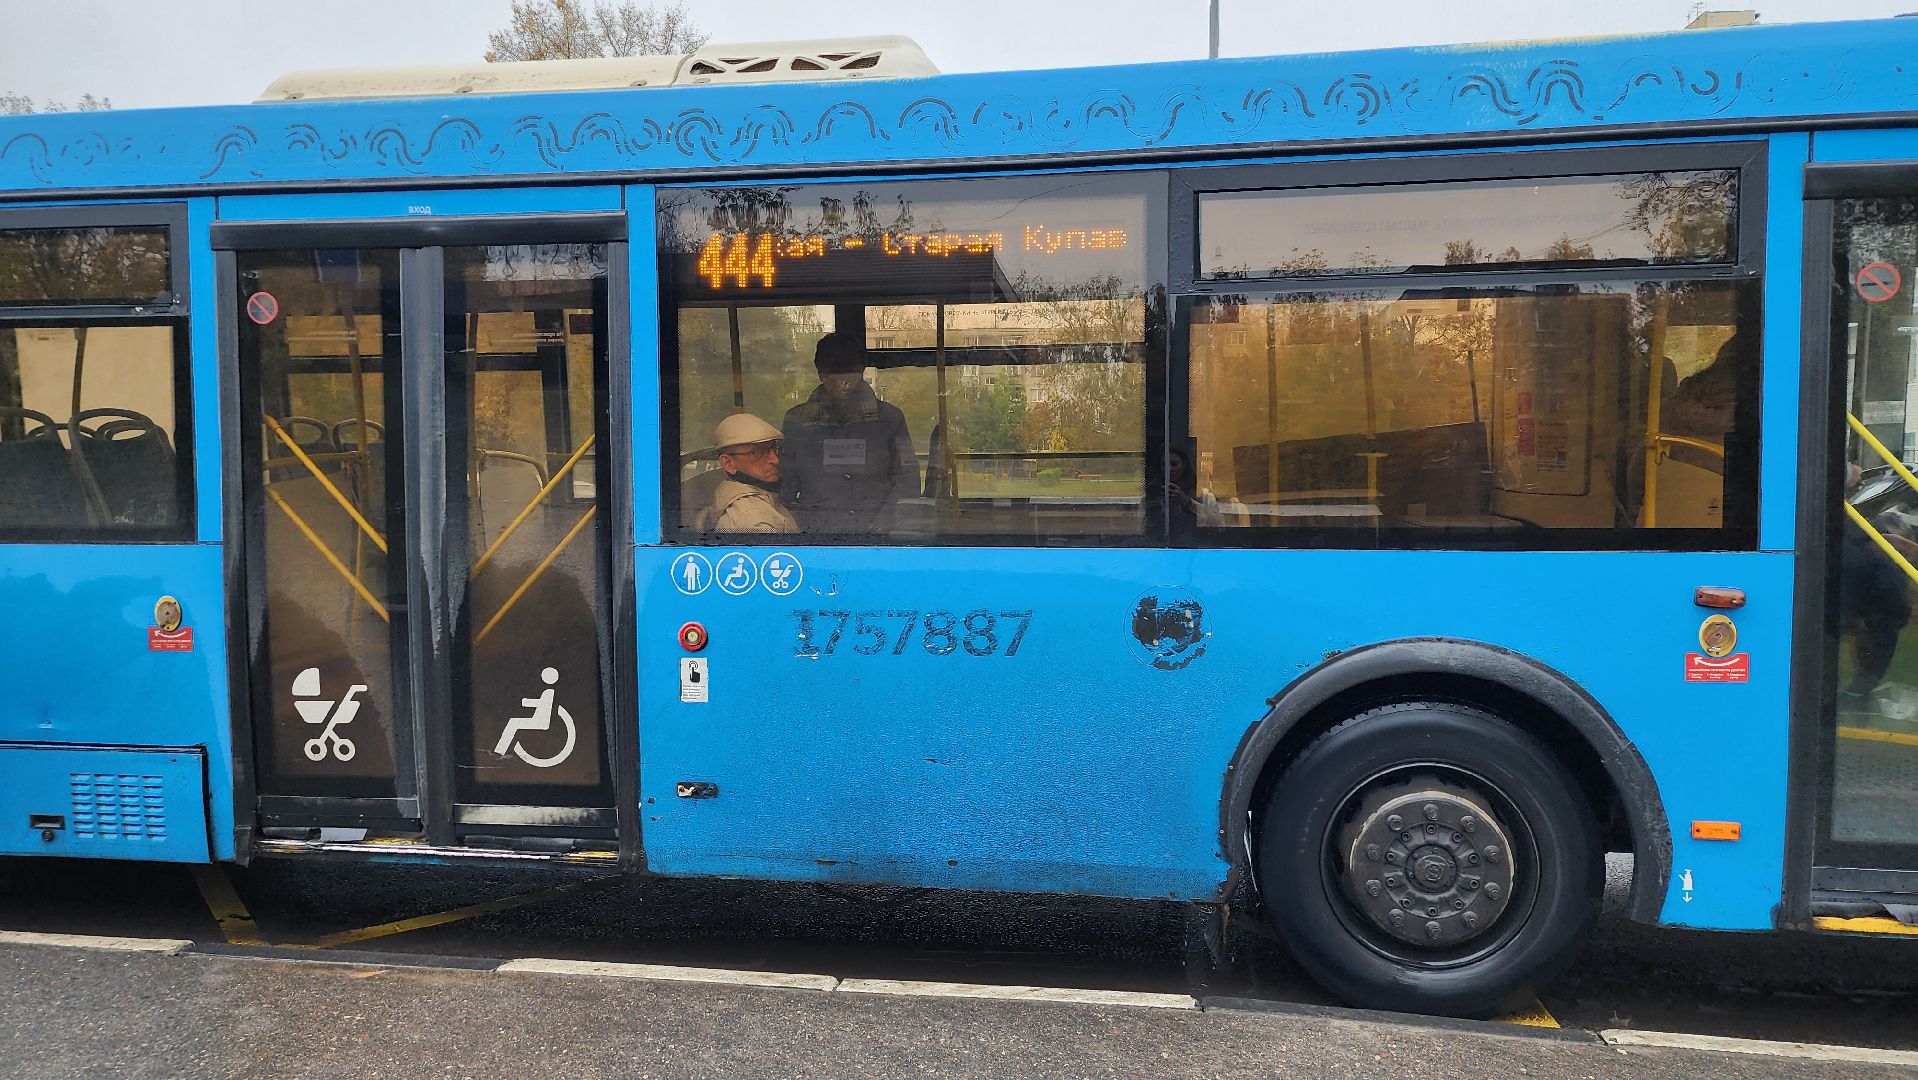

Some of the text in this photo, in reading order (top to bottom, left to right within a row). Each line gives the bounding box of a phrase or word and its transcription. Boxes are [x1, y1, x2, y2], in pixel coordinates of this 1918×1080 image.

[698, 231, 776, 289] 444
[883, 231, 1003, 257] Старая
[1025, 223, 1128, 254] Купав
[792, 608, 1034, 660] 1757887
